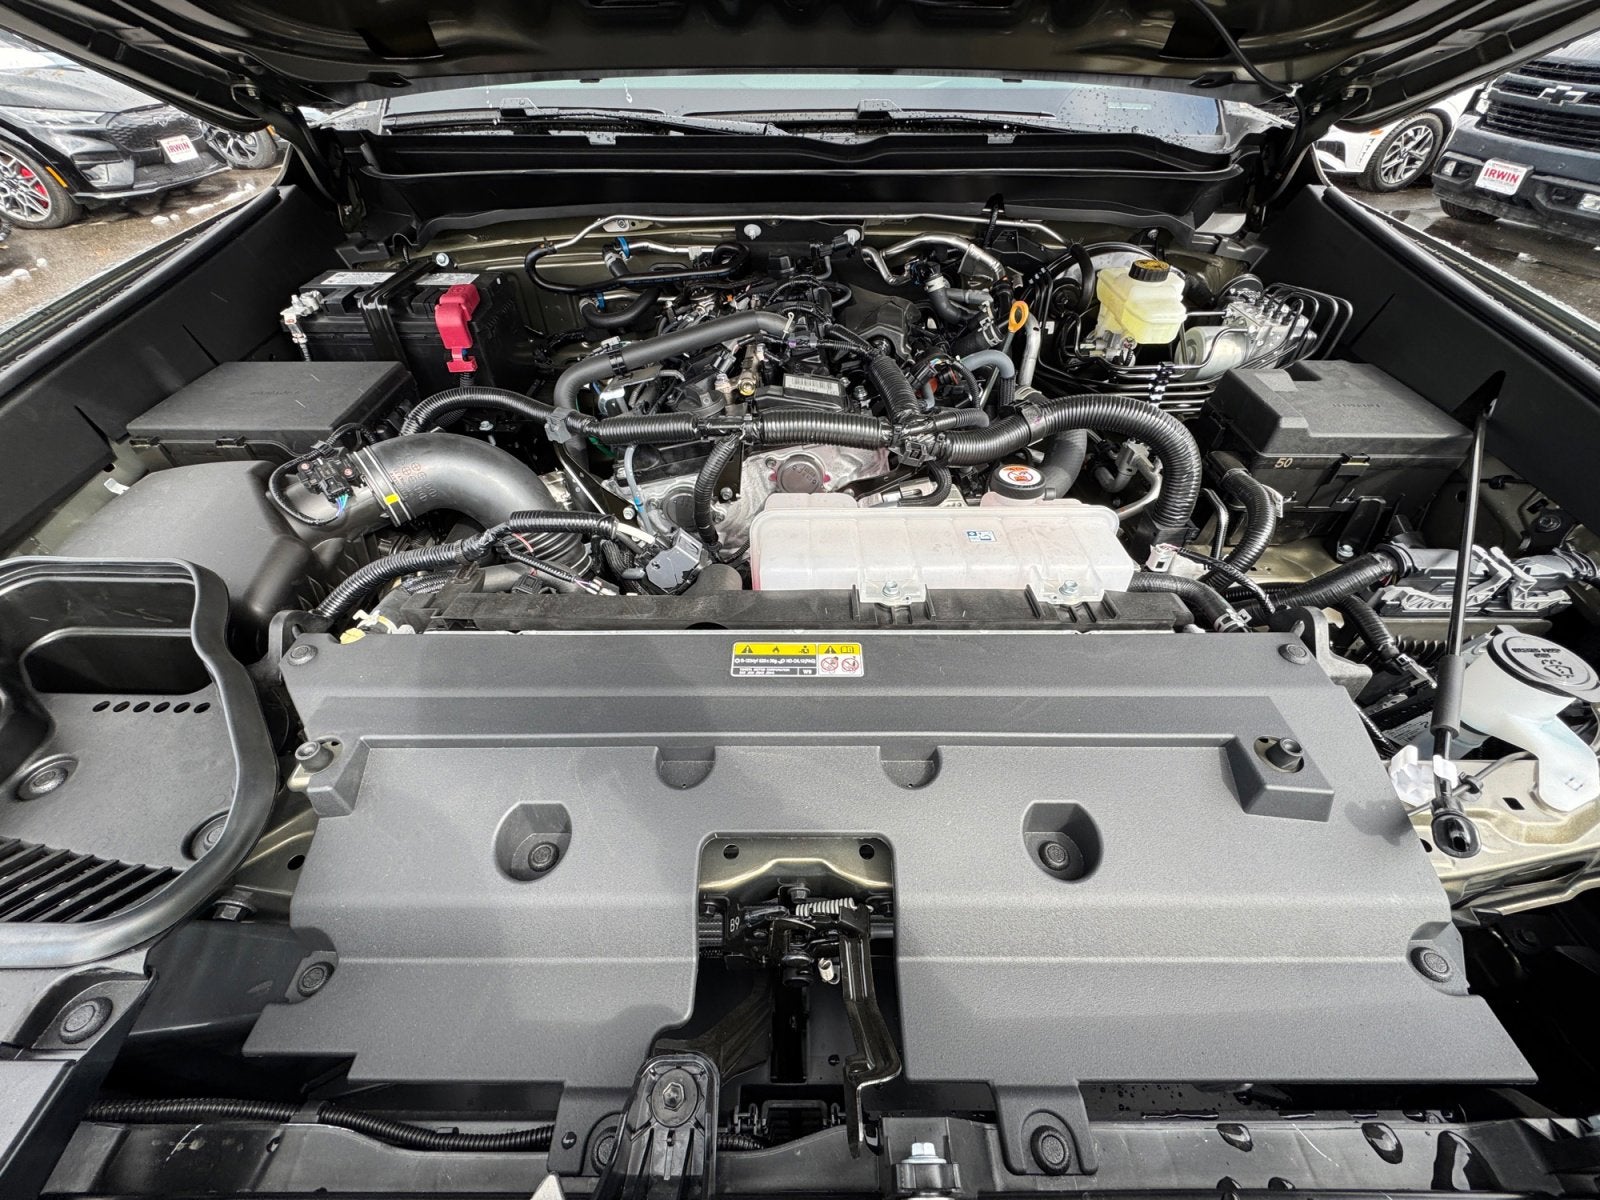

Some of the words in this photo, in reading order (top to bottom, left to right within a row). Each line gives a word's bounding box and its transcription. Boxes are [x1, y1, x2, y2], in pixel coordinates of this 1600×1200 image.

[166, 141, 190, 153] IRWIN
[1484, 168, 1520, 184] IRWIN
[1274, 457, 1293, 468] 50
